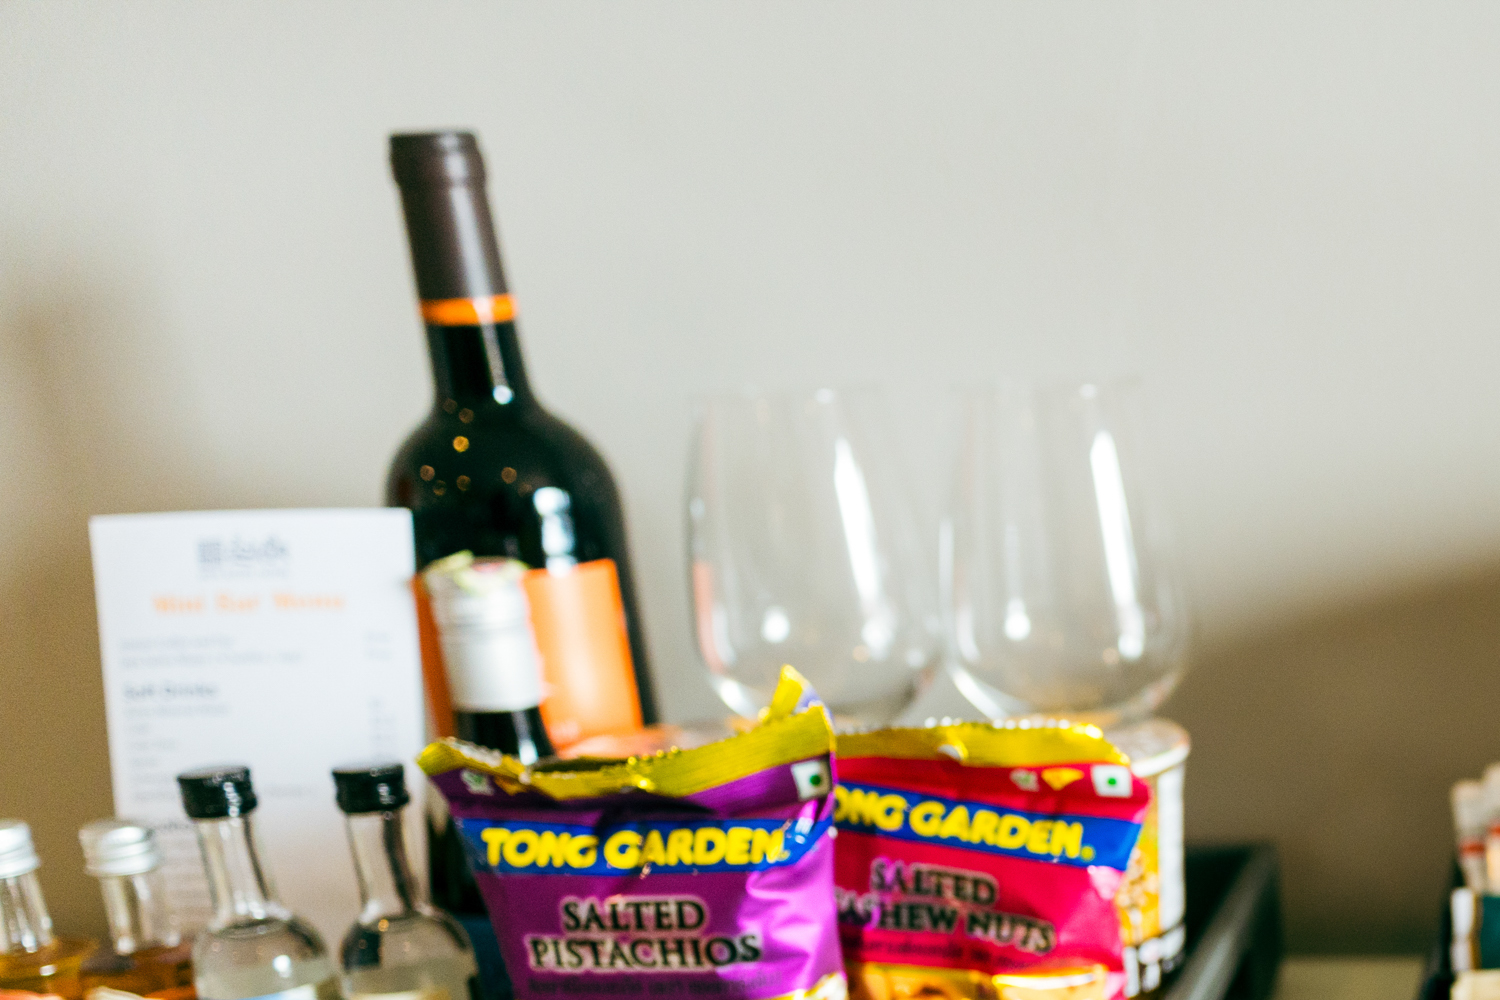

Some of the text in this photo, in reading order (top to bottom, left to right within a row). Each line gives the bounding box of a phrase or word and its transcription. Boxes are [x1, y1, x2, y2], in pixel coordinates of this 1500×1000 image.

[834, 785, 1084, 858] ONG GARDEN
[481, 827, 785, 869] TONG GARDEN
[874, 861, 996, 906] SALTED
[562, 899, 706, 932] SALTED
[835, 889, 958, 931] ASHEW
[967, 911, 1054, 953] NUTS
[530, 934, 762, 969] PISTACHIOS
